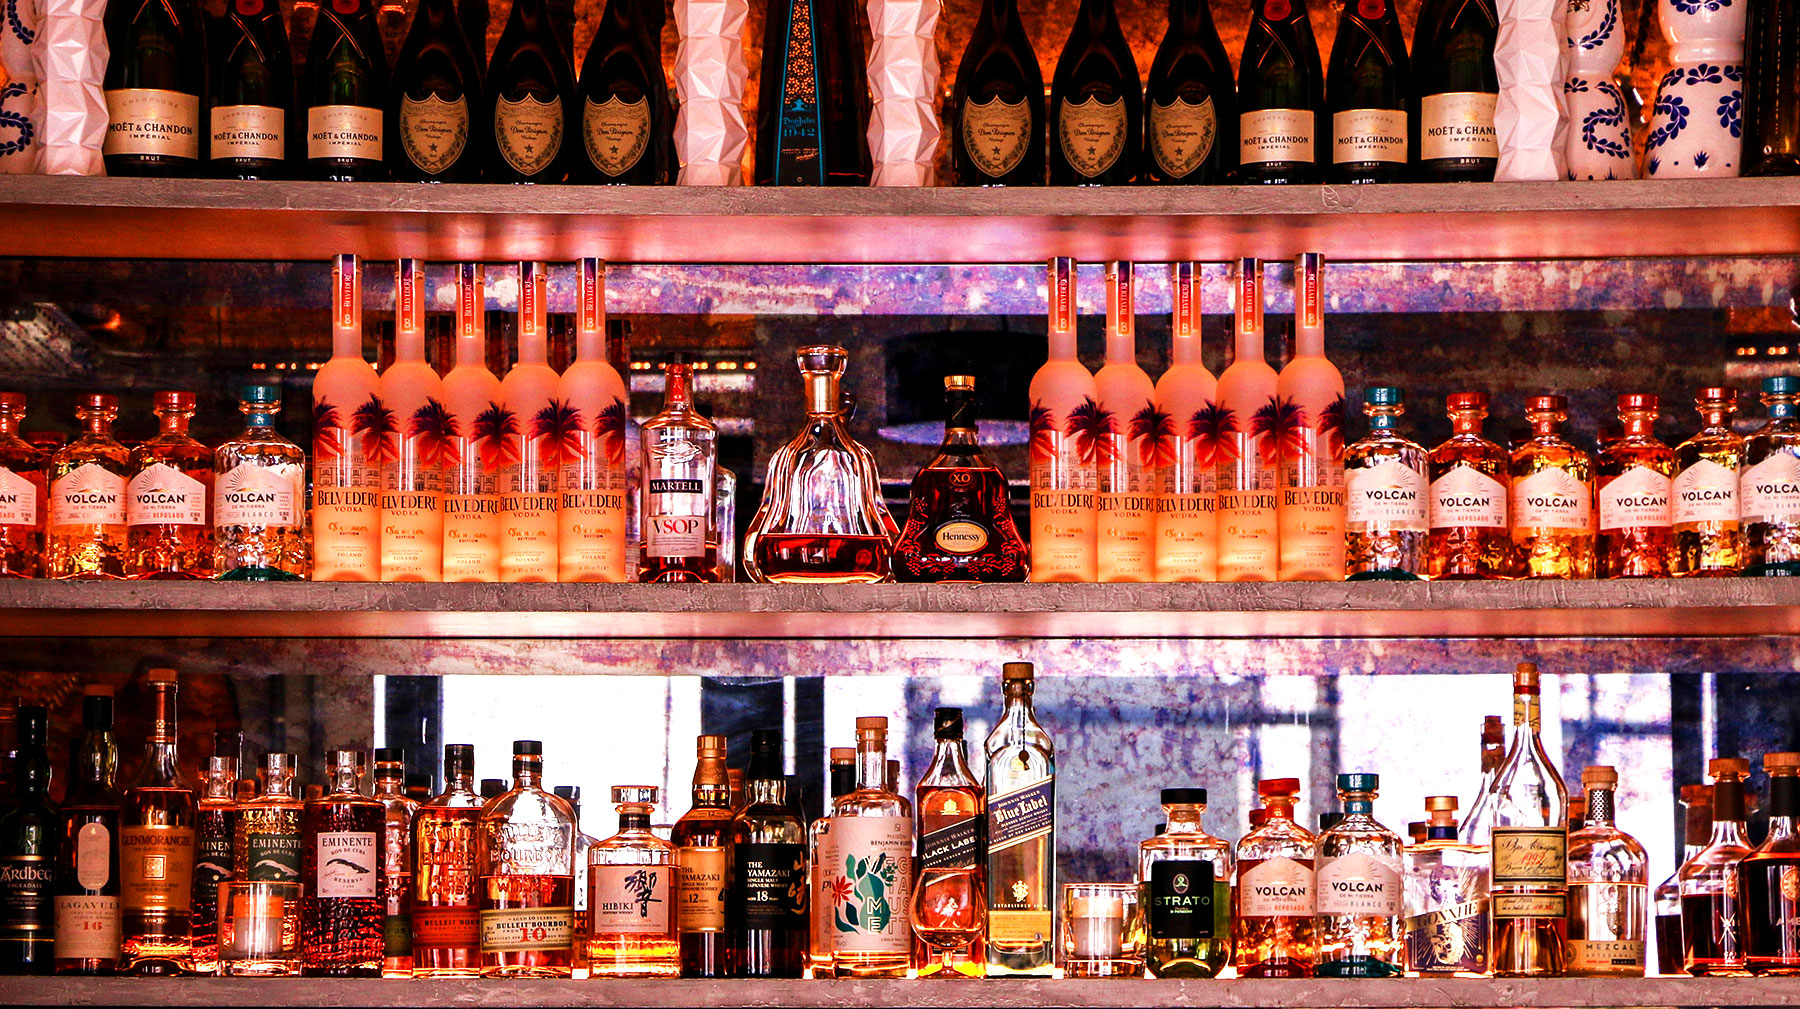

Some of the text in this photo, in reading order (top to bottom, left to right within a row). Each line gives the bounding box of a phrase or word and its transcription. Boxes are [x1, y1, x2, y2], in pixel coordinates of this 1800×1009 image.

[136, 124, 142, 132] &
[144, 122, 193, 136] CHANDON
[414, 125, 428, 133] Dom
[511, 126, 525, 135] Dom
[596, 127, 610, 136] Dom
[783, 127, 816, 137] 1942
[978, 128, 992, 136] Dom
[1073, 128, 1087, 136] Dom
[1456, 127, 1462, 135] &
[1464, 126, 1496, 136] CHAN
[238, 131, 279, 142] CHANDON
[340, 132, 379, 142] CHANDON
[1268, 135, 1309, 144] CHANDON
[1366, 135, 1404, 145] CHANDON
[953, 473, 971, 483] XO
[652, 481, 701, 491] MARTELL
[1756, 484, 1800, 494] VOLCA
[65, 494, 116, 504] VOLCAN
[136, 494, 185, 504] VOLCAN
[225, 493, 275, 503] VOLCAN
[1366, 490, 1416, 500] VOLCAN
[1681, 490, 1731, 501] VOLCAN
[381, 495, 438, 511] ELVEDERE
[444, 499, 499, 515] ELVEDERE
[1439, 497, 1489, 507] VOLCAN
[1527, 498, 1577, 507] VOLCAN
[1616, 497, 1667, 507] VOLCAN
[653, 519, 699, 534] VSOP
[942, 532, 981, 544] Hennessy
[992, 795, 1049, 825] Blue Label
[122, 835, 192, 847] GLENMORANGIE
[252, 838, 302, 849] EMINENTE
[322, 837, 373, 847] EMINENTE
[925, 828, 975, 850] JOHNNIE WALKER
[747, 861, 763, 869] THE
[747, 869, 790, 877] YAMAZAKI
[1255, 886, 1306, 896] VOLCAN
[1332, 882, 1383, 892] VOLCAN
[689, 894, 699, 904] 12
[756, 890, 769, 901] 18
[60, 902, 119, 910] LAGAVULI
[1154, 896, 1211, 906] STRATO
[602, 902, 634, 911] HIBIKI
[83, 921, 103, 931] 16
[532, 921, 567, 929] BOURBON
[520, 926, 547, 942] 10
[1586, 943, 1634, 951] MEZCAL
